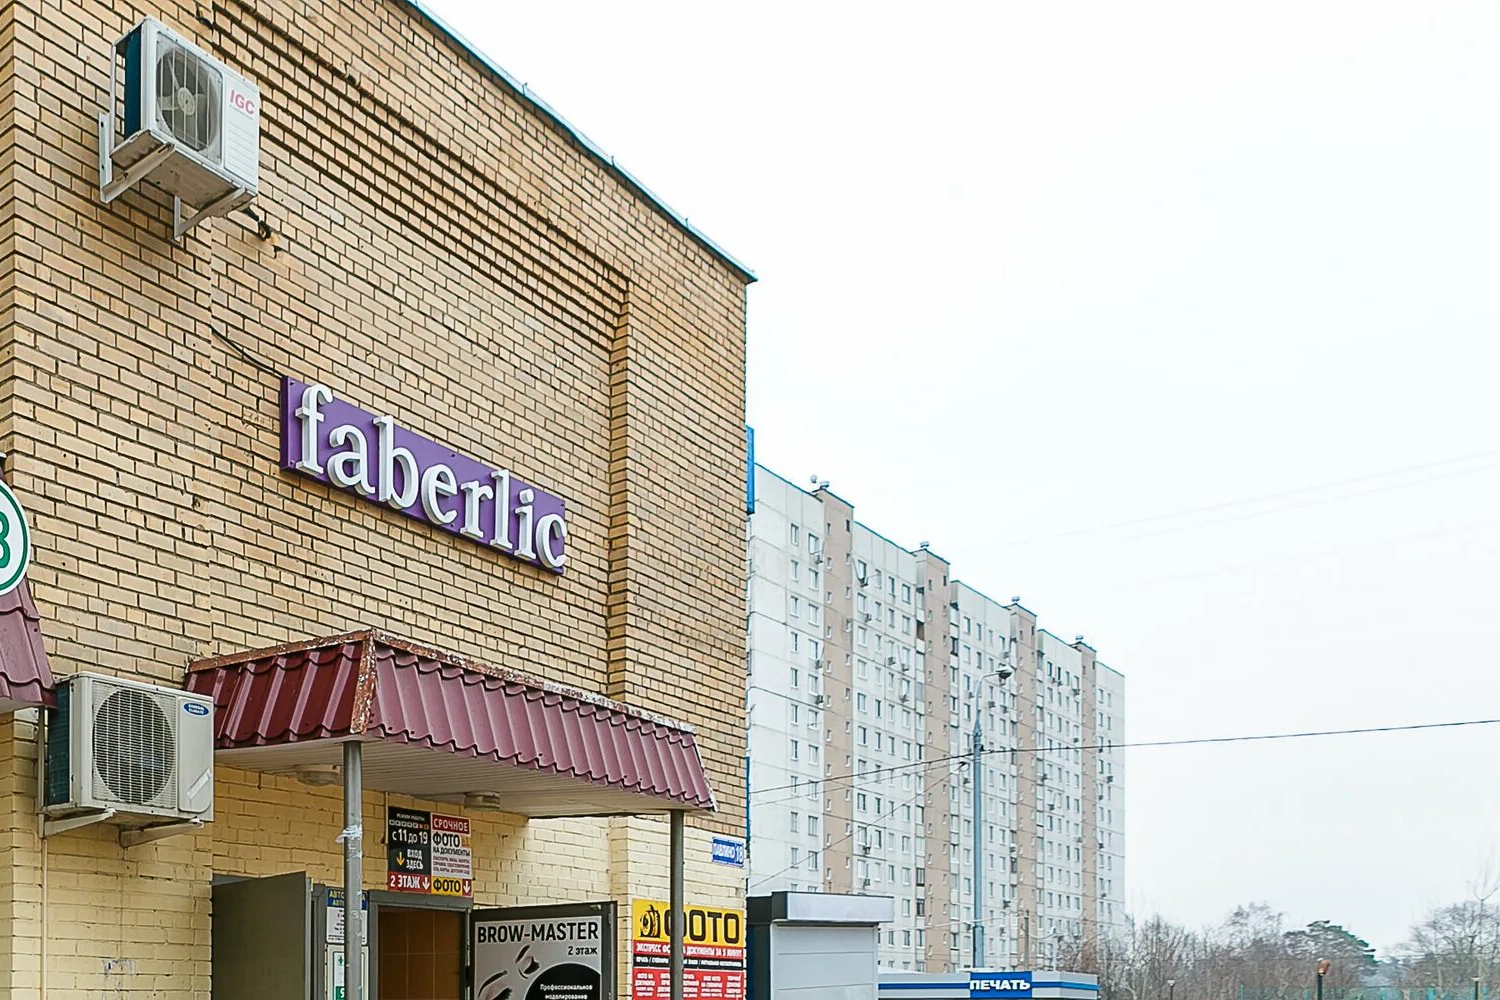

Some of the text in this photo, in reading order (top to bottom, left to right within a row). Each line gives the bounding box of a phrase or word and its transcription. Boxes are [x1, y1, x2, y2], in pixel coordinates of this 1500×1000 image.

[230, 90, 255, 115] IGC
[295, 383, 568, 570] faberlic
[433, 818, 468, 832] СРОЧНОЕ
[398, 829, 407, 842] 11
[419, 831, 428, 844] 19
[433, 831, 460, 848] ФОТО
[406, 849, 422, 860] ВХОД
[440, 847, 470, 857] ДОКУМЕНТЫ
[406, 859, 423, 870] ЗДЕСЬ
[390, 874, 420, 889] 2 ЭТАЖ
[433, 878, 461, 892] ФОТО
[477, 921, 599, 943] BROW-MASTER
[568, 945, 598, 956] 2 этаж
[969, 980, 1031, 991] ПЕЧАТЬ
